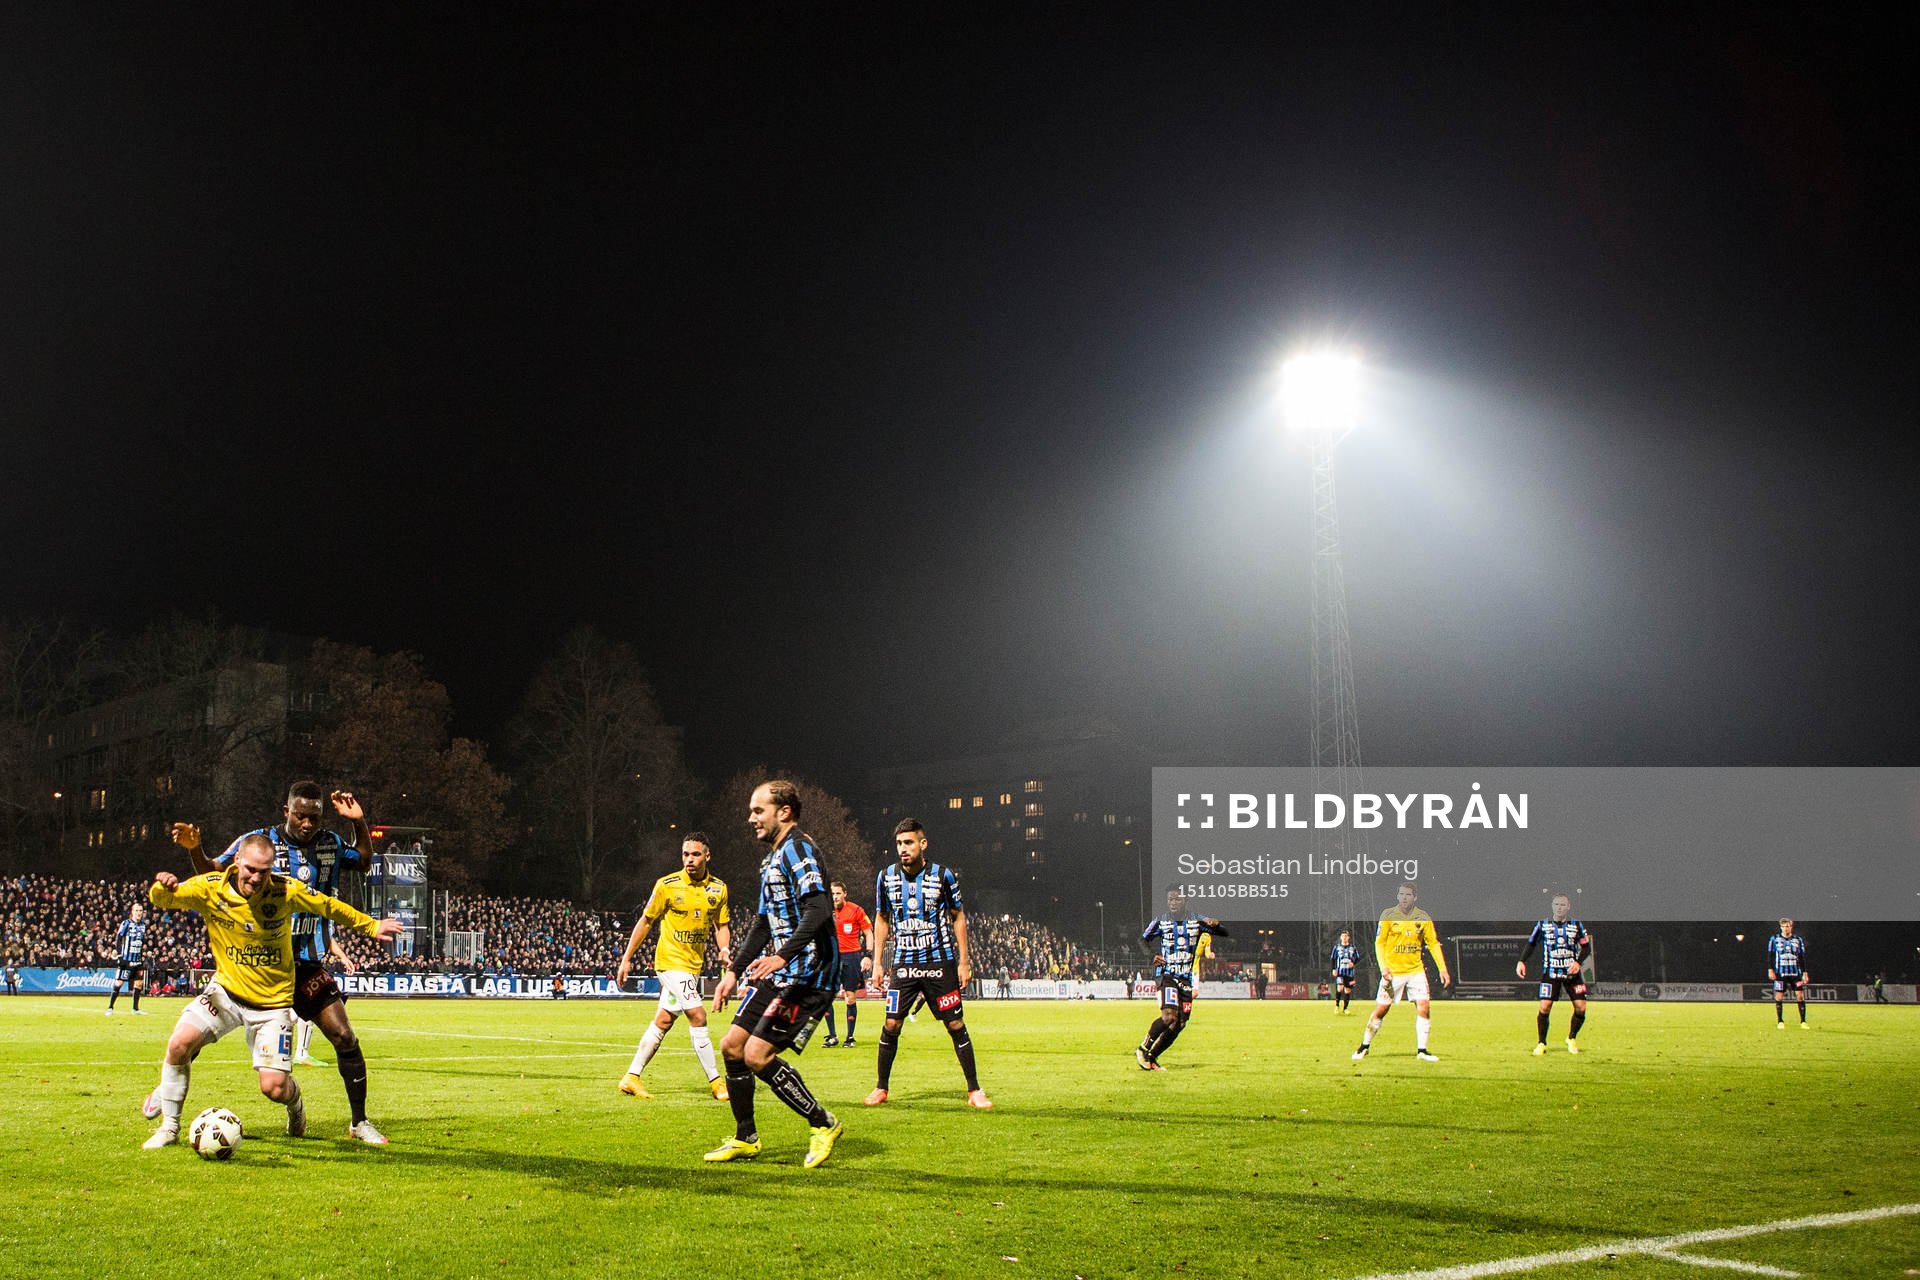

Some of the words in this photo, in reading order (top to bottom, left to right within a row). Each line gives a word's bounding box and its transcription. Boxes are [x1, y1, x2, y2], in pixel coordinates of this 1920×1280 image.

[388, 862, 420, 877] UNT.
[908, 967, 943, 978] Koneo
[394, 975, 466, 994] BÄSTA
[470, 978, 511, 994] LAG
[516, 979, 523, 994] I
[527, 978, 619, 995] UPSALA
[680, 979, 695, 993] 70
[939, 995, 959, 1009] JÖTA
